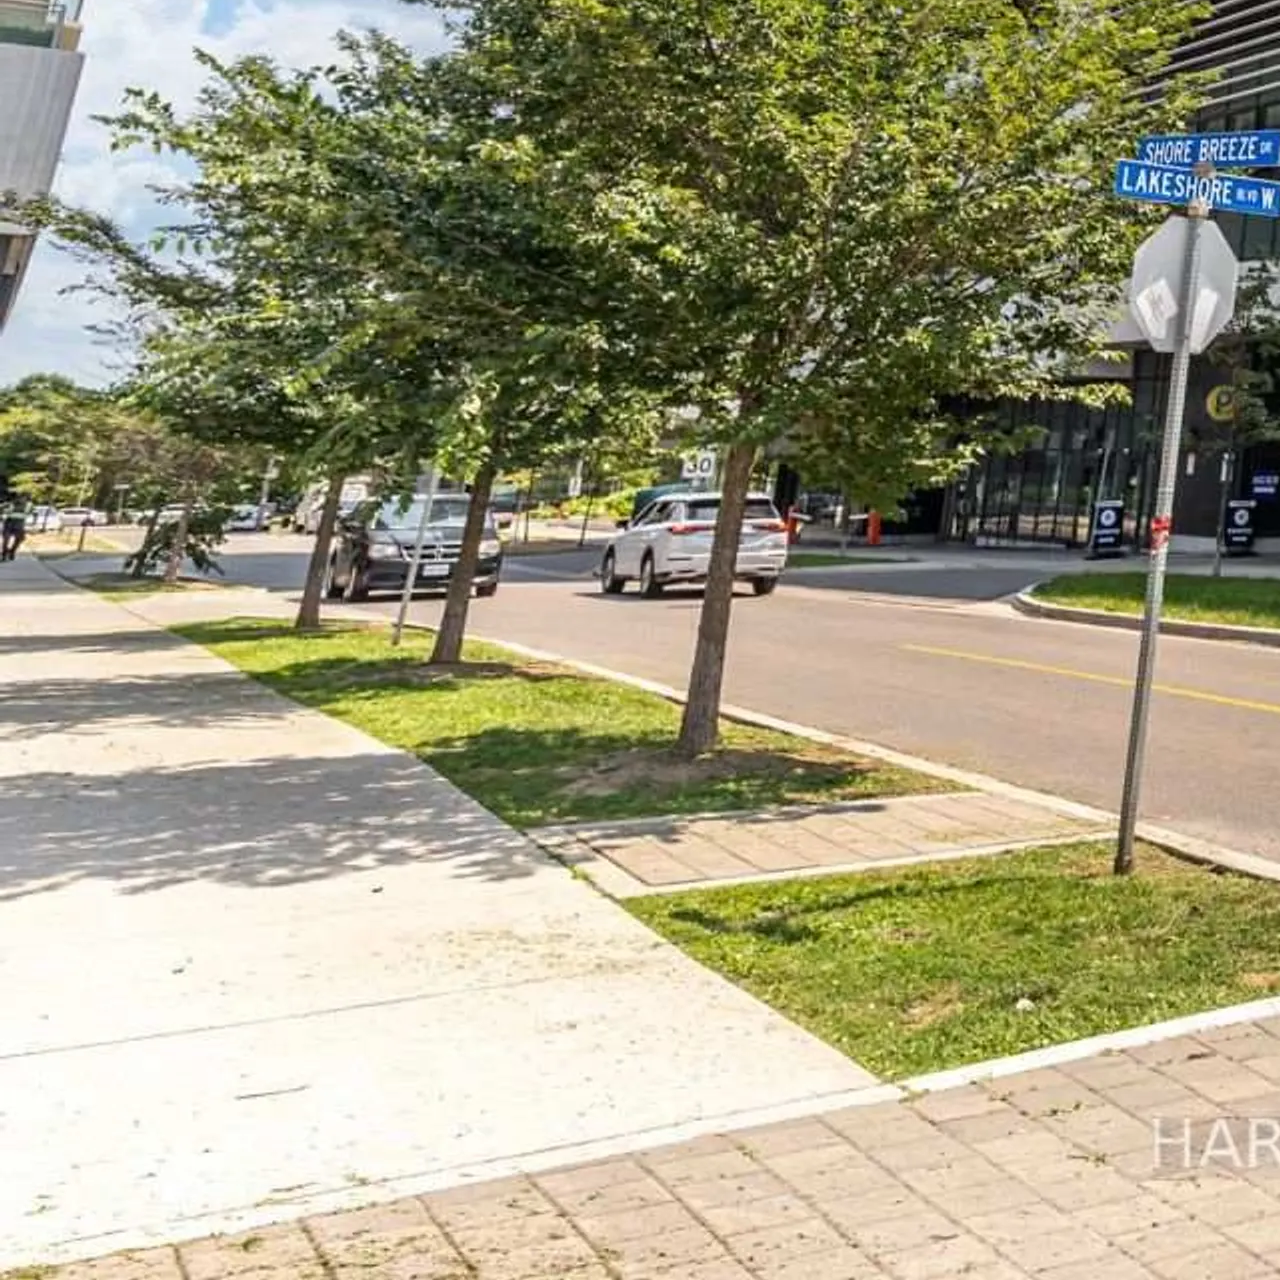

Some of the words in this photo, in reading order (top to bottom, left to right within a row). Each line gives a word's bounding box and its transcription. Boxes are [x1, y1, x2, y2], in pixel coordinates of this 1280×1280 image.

[1146, 139, 1193, 164] SHORE
[1199, 136, 1259, 161] BREEZE
[1122, 167, 1232, 205] LAKESHORE
[1261, 187, 1276, 210] W
